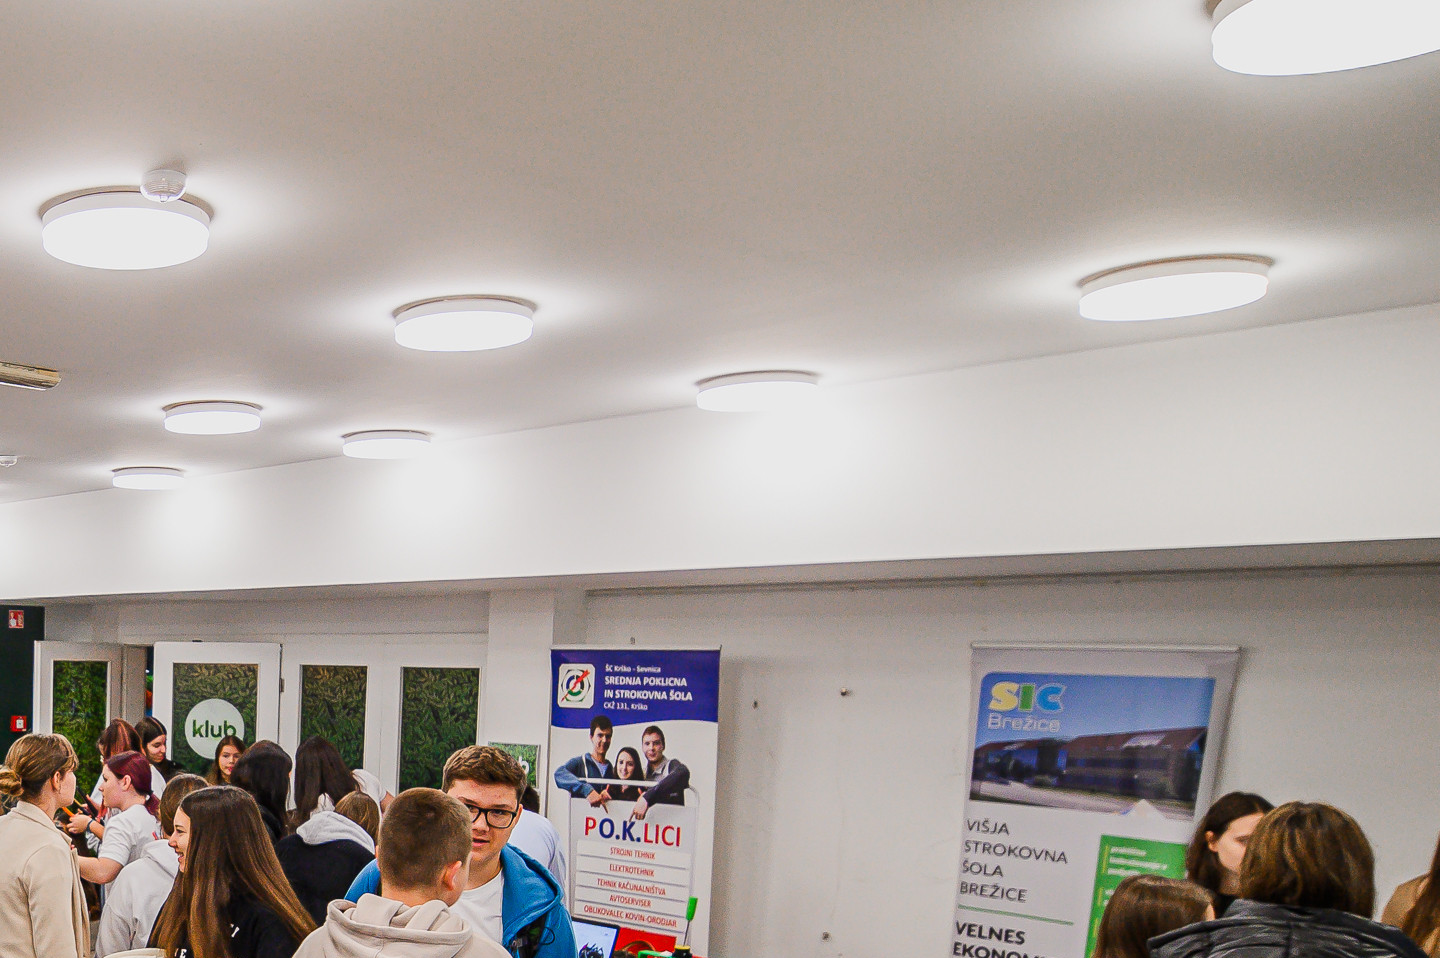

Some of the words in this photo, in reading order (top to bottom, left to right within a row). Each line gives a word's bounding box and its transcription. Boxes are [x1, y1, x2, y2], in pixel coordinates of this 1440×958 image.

[604, 675, 642, 686] SREDNJA
[603, 689, 614, 699] IN
[615, 689, 668, 700] STROKOVNA
[669, 689, 693, 701] ŠOLA
[192, 719, 237, 738] klub
[987, 712, 1061, 733] Brežice
[966, 817, 1010, 836] VIŠJA
[964, 839, 1068, 865] STROKOVNA
[962, 857, 1004, 877] ŠOLA
[960, 881, 1027, 903] BREŽICE
[956, 920, 1026, 945] VELNES
